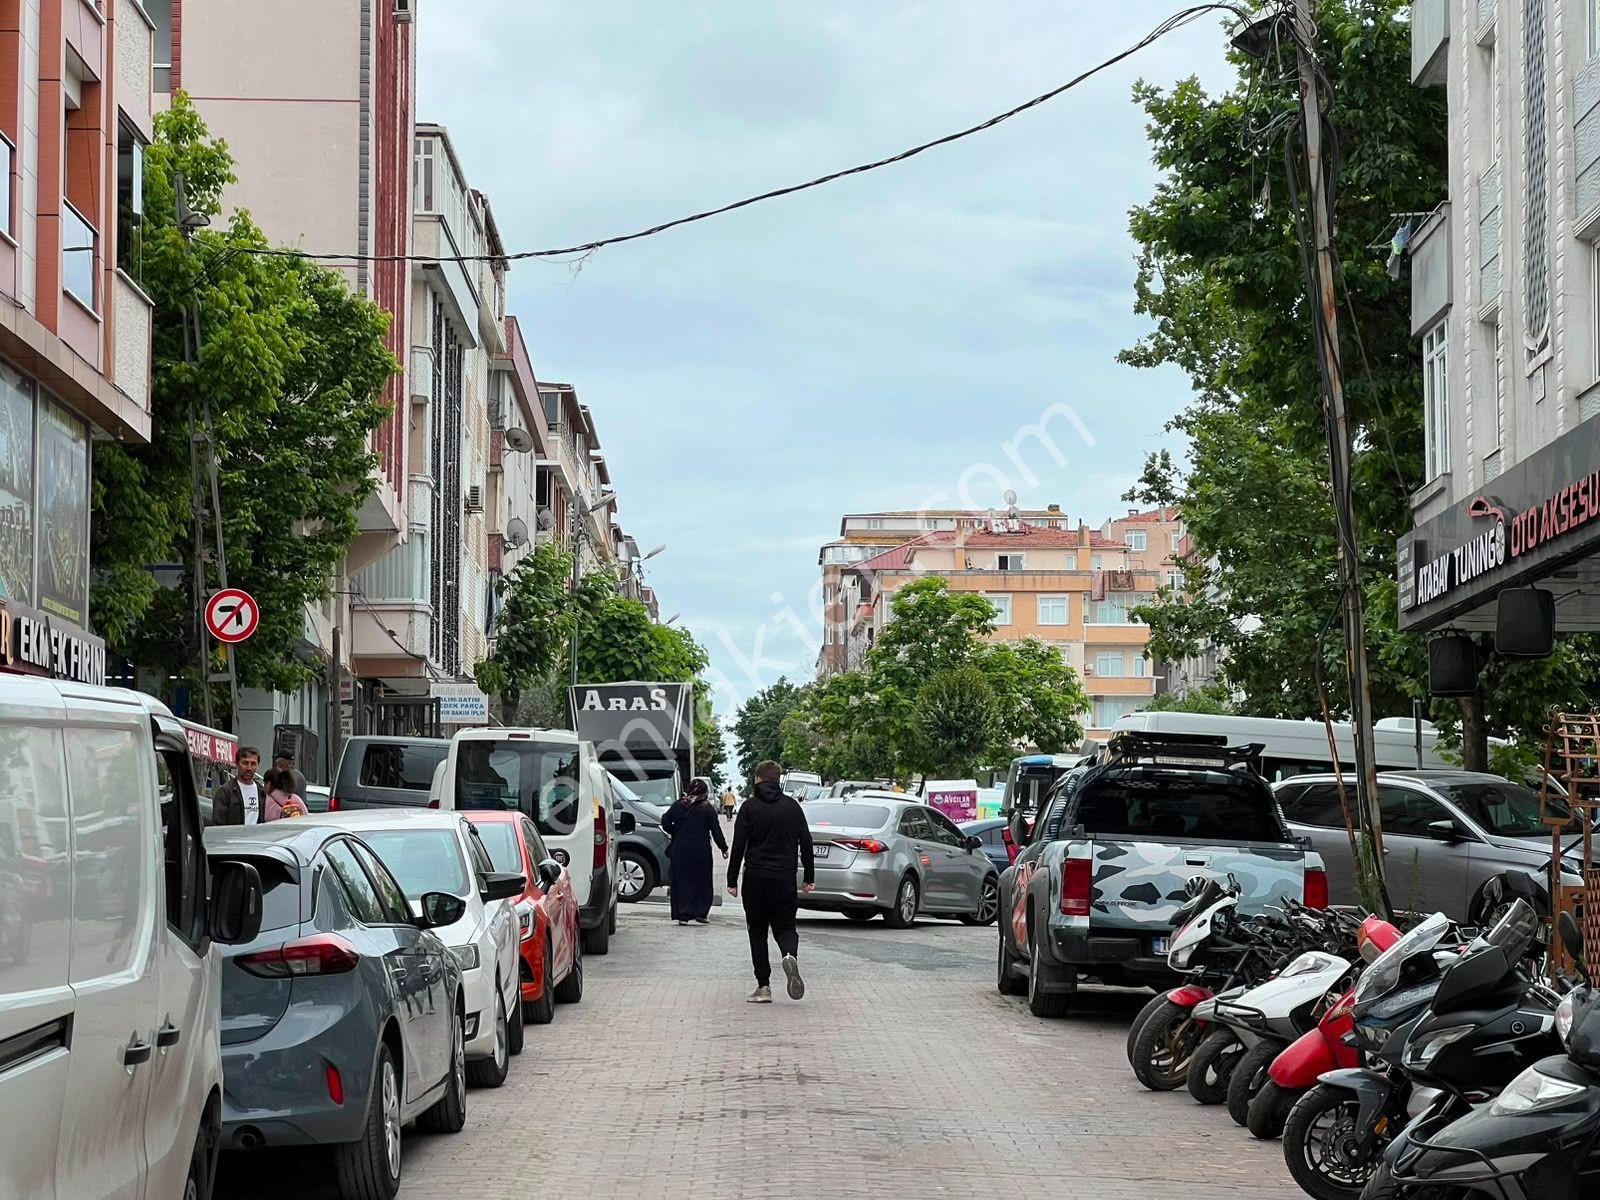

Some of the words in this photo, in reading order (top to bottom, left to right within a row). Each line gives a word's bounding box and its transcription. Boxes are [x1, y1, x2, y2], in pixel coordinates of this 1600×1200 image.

[1511, 504, 1538, 557] OTO
[1540, 469, 1600, 544] AKSESU
[1417, 553, 1451, 606] ATABAY
[1453, 527, 1496, 586] TUNING
[20, 615, 68, 675] EKMEK
[70, 636, 106, 687] FIRINI
[461, 702, 484, 710] PARÇA
[815, 846, 827, 854] 317
